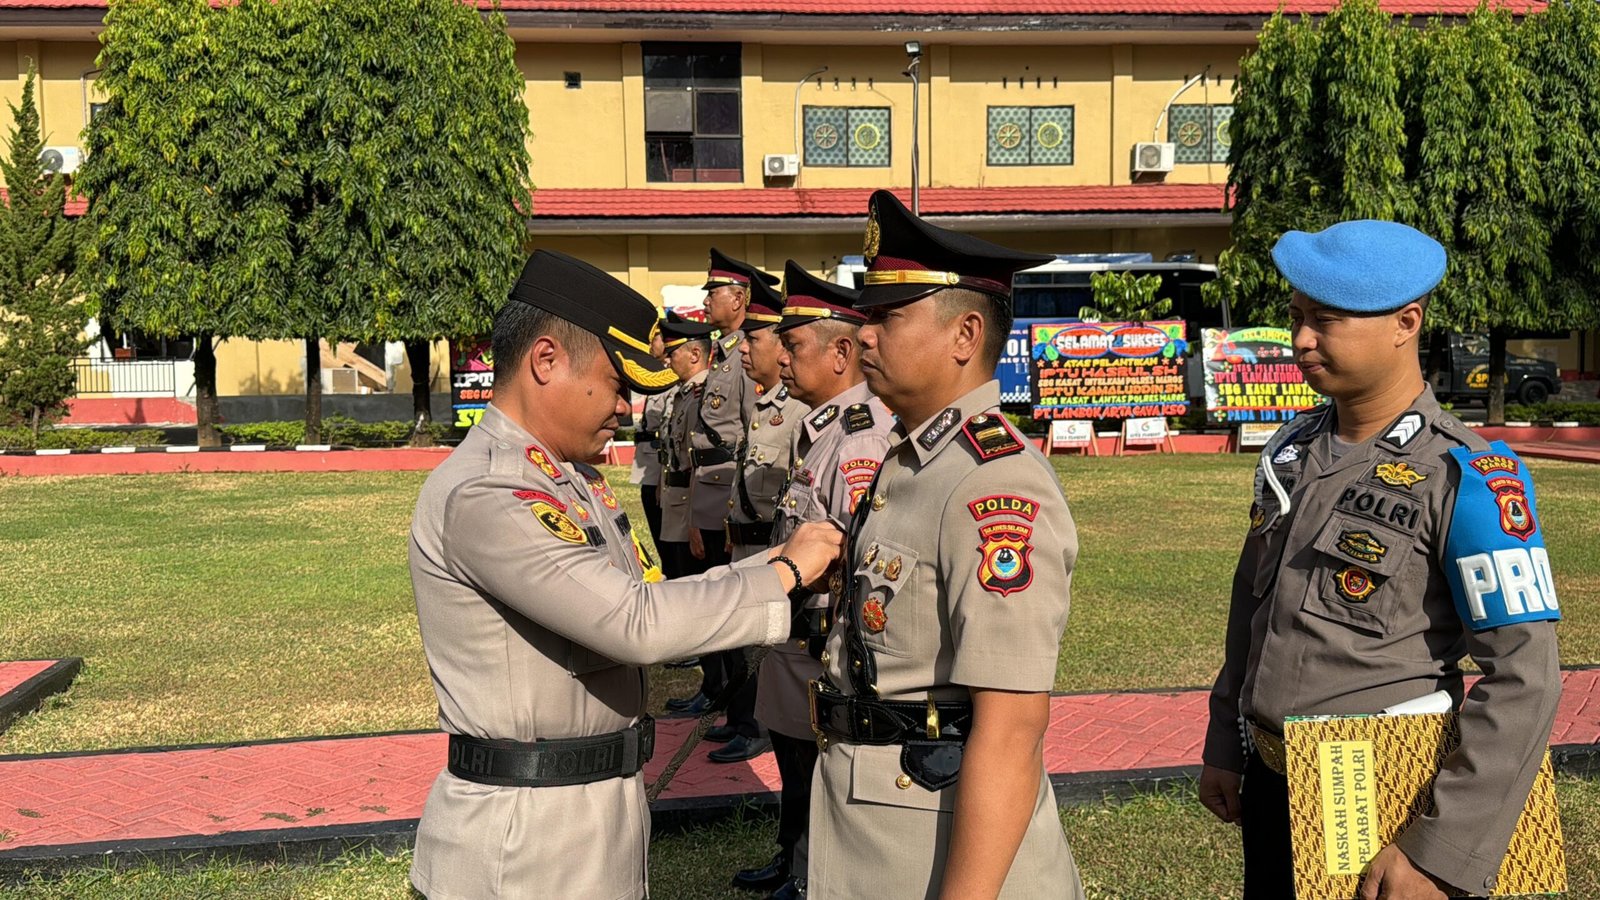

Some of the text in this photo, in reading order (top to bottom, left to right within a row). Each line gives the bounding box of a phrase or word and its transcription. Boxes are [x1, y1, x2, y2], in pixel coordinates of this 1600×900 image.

[1056, 335, 1114, 349] SELAMAT
[1123, 333, 1166, 347] SUKSES
[1063, 357, 1158, 367] ATAS PELANTIKAN
[1039, 365, 1177, 379] IPTU HASRUL SH
[1214, 372, 1238, 383] IPTU
[453, 372, 494, 388] IPT
[1055, 378, 1082, 387] KASAT
[1084, 377, 1125, 386] INTELKAM
[1125, 376, 1154, 385] POLRES
[1155, 375, 1183, 384] MAROS
[460, 389, 480, 400] SBG
[1039, 384, 1183, 397] IPTU KAMALUDDIN SH
[1218, 383, 1241, 395] SBG
[1245, 383, 1278, 395] KASAT
[1060, 396, 1089, 405] KASAT
[1092, 395, 1127, 404] LANTAS
[1127, 394, 1159, 403] POLRES
[1226, 395, 1314, 407] POLRES MAROS
[1228, 410, 1255, 421] PADA
[843, 460, 877, 470] POLDA
[974, 497, 1032, 515] POLDA
[1339, 488, 1420, 529] POLRI
[536, 744, 616, 778] POLRI
[1330, 744, 1351, 871] NASKAH SUMPAH
[1352, 749, 1371, 865] PEJABAT POLRI
